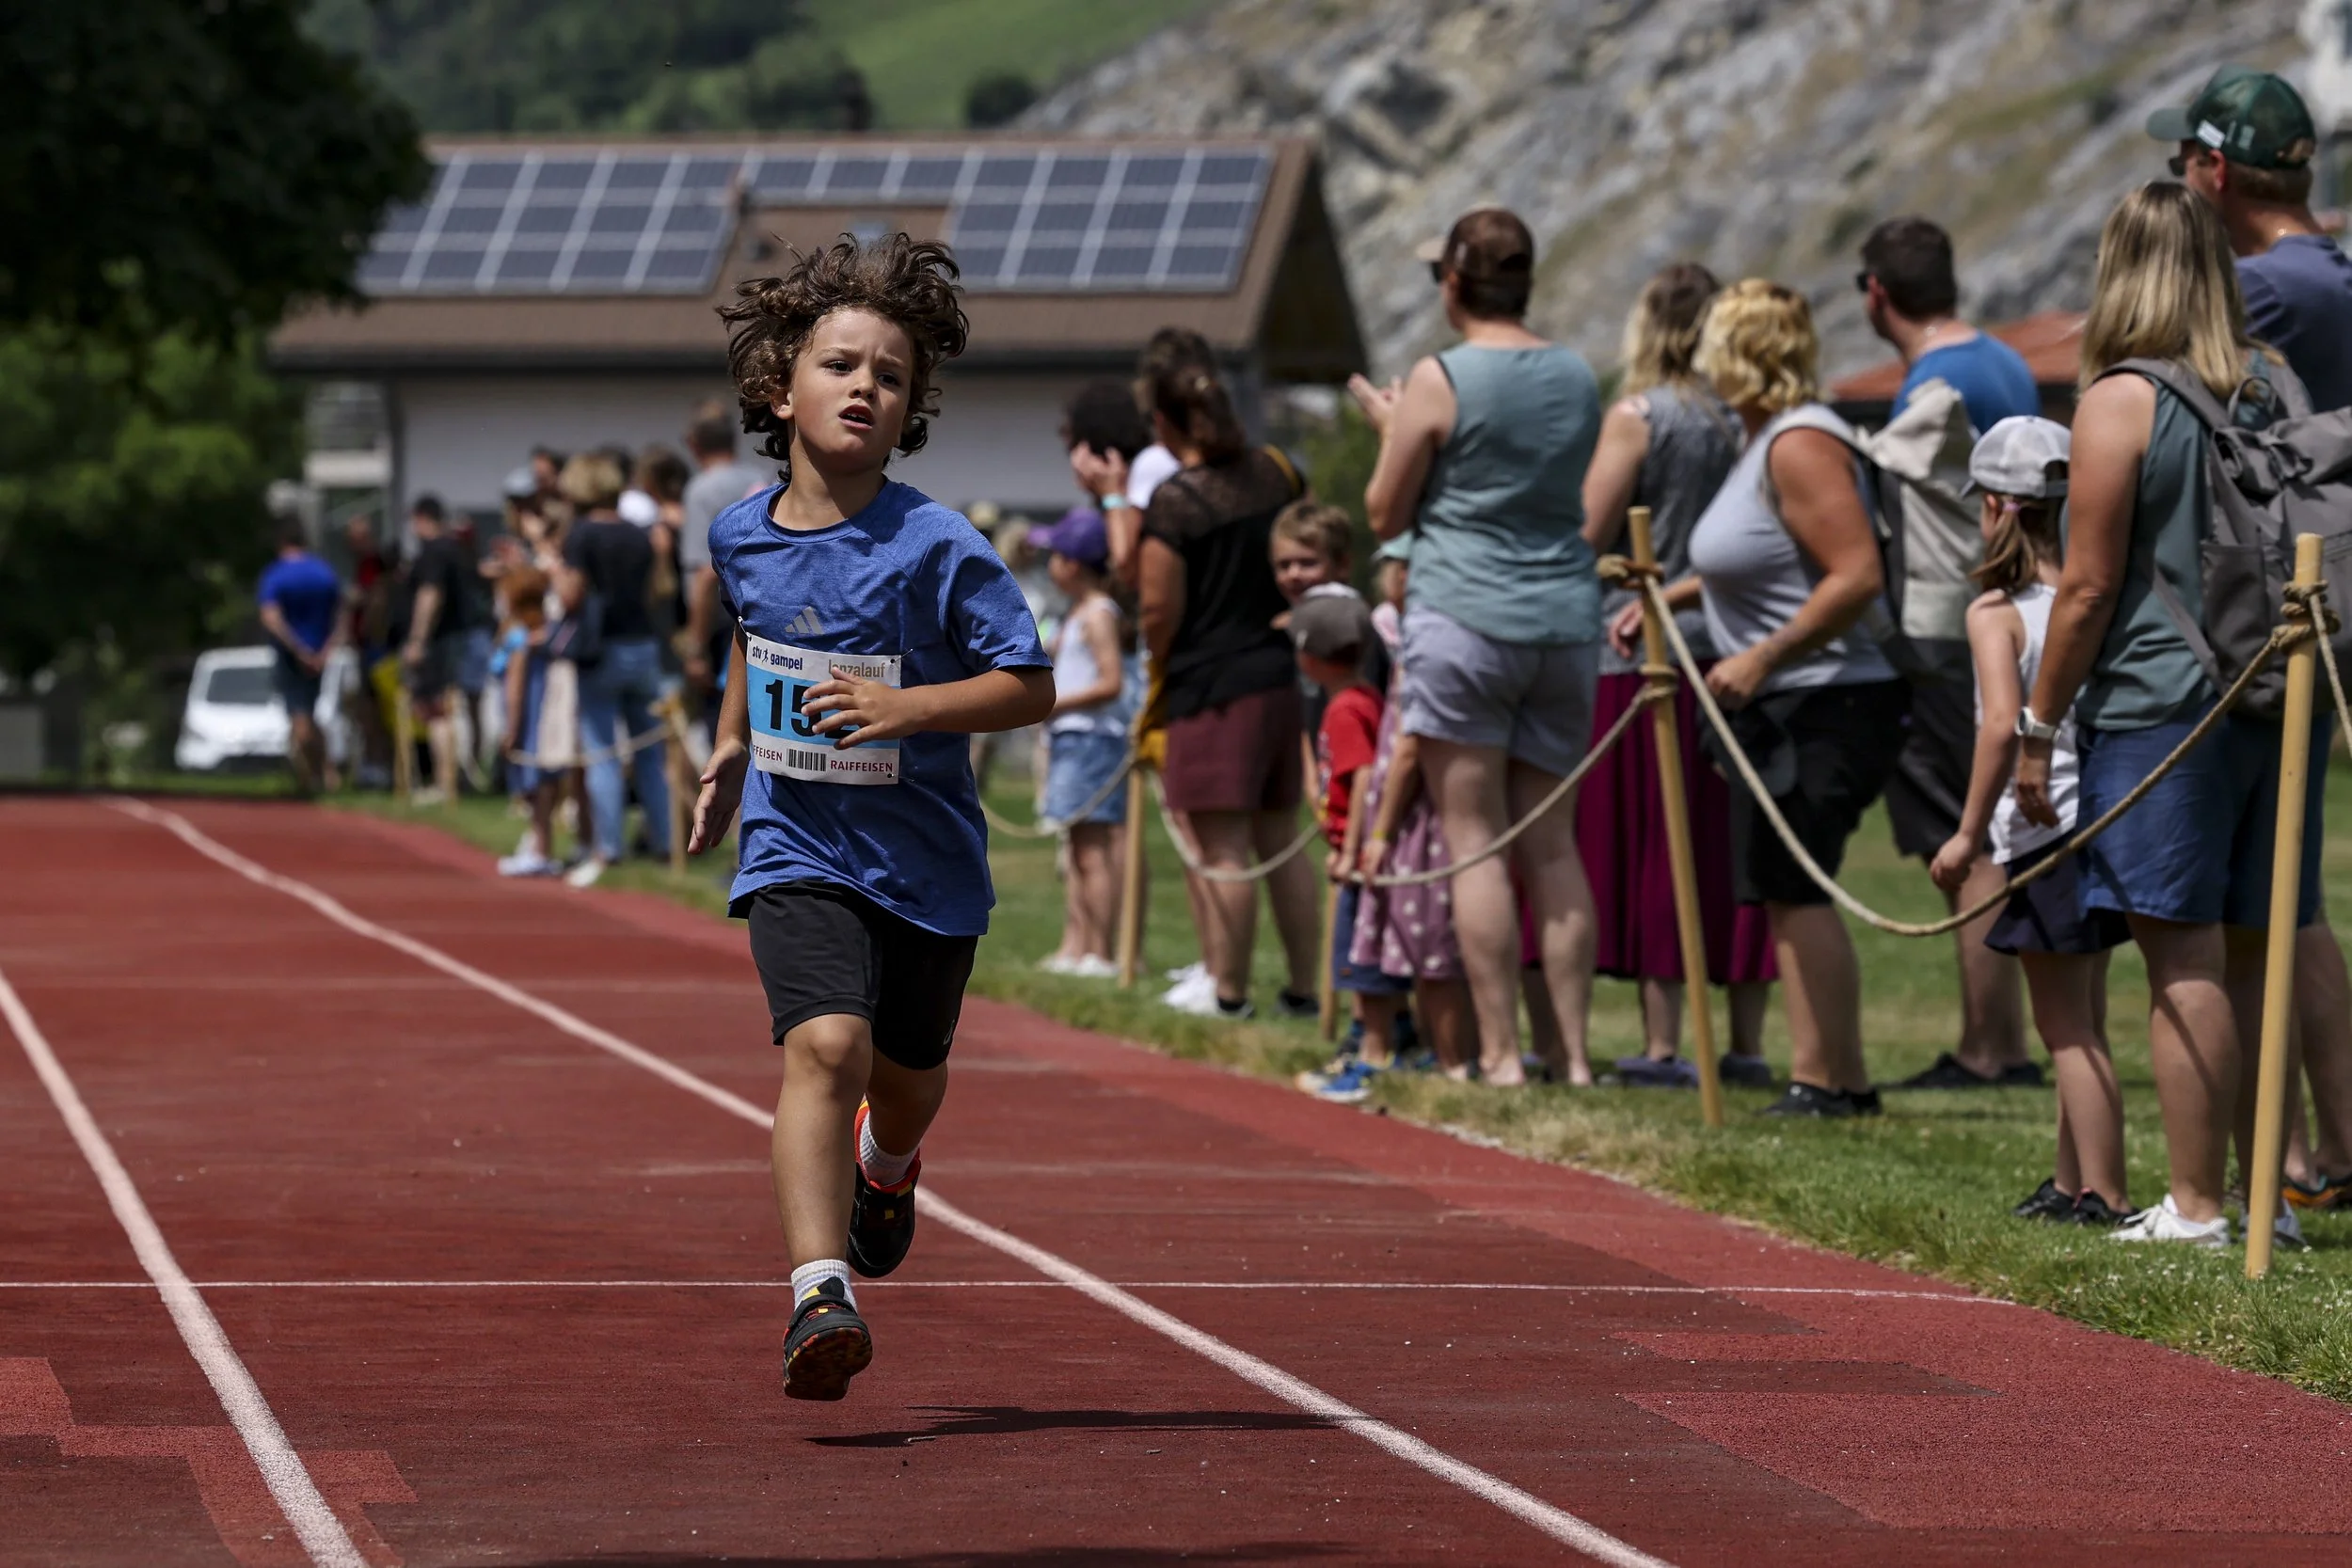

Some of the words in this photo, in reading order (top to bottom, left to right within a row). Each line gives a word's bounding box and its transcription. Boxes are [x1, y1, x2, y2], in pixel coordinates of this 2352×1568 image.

[752, 645, 762, 659] stv
[771, 653, 803, 671] gampel
[765, 678, 863, 739] 15
[830, 760, 893, 772] RAIFFEISEN
